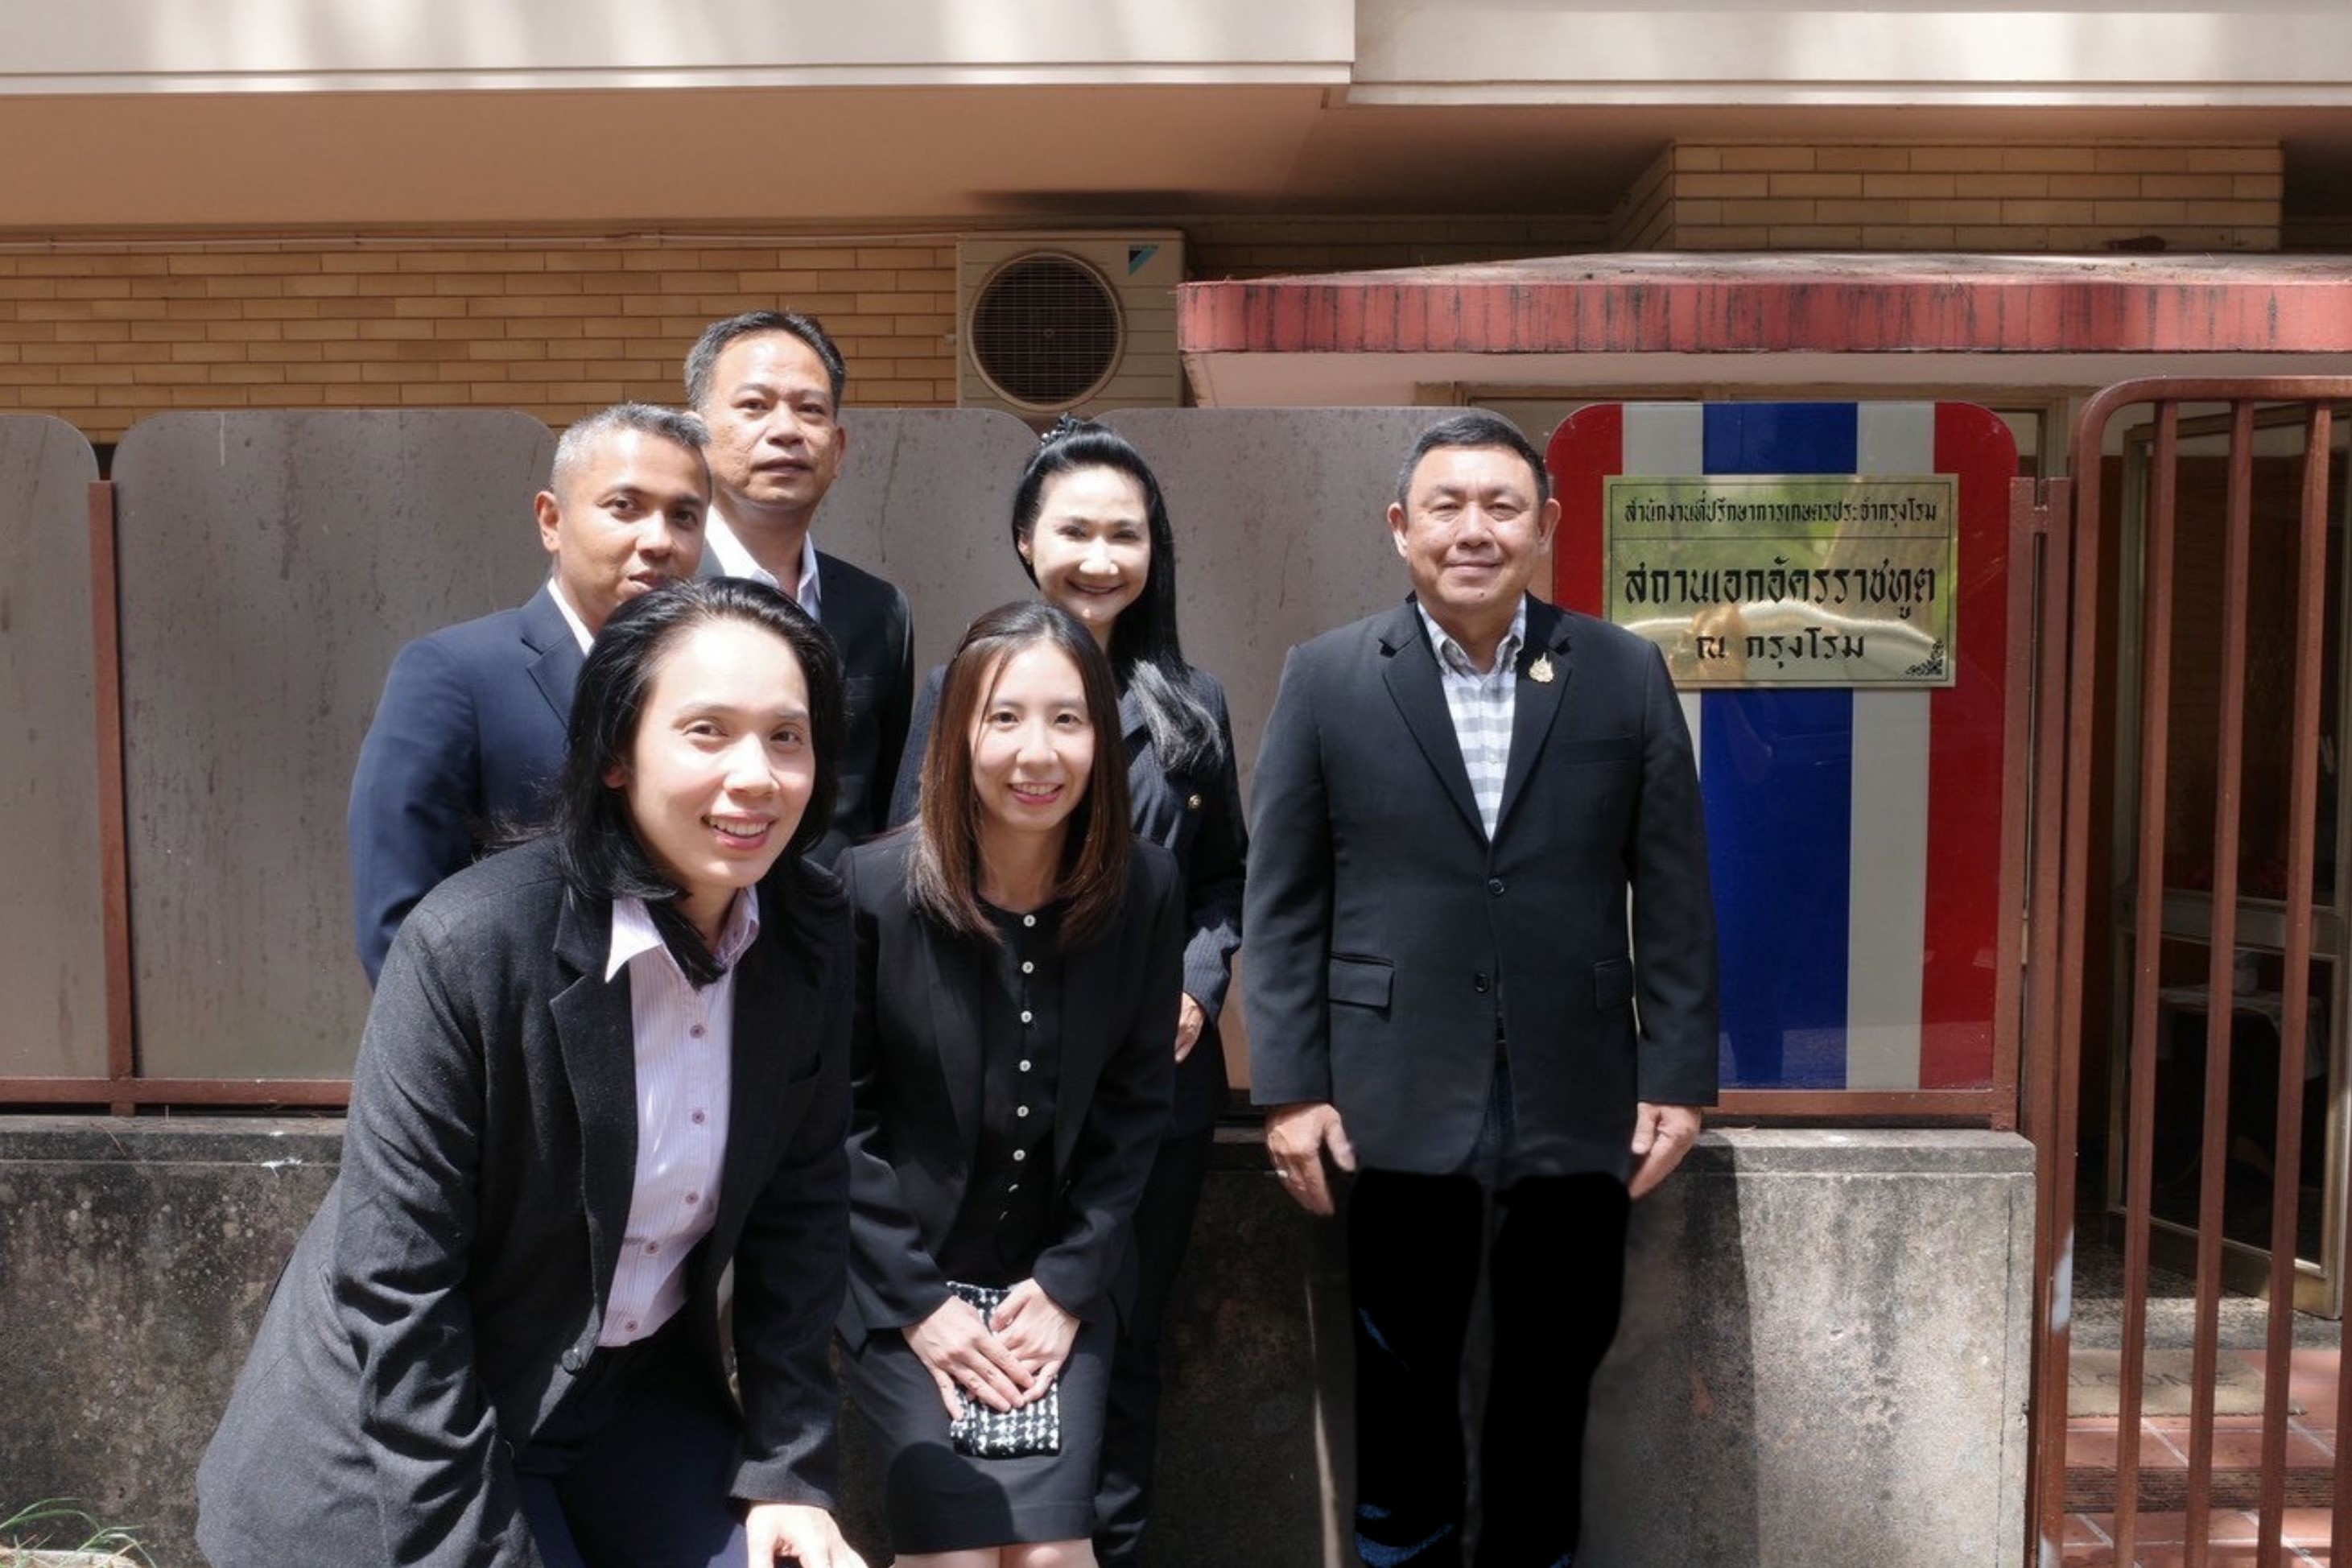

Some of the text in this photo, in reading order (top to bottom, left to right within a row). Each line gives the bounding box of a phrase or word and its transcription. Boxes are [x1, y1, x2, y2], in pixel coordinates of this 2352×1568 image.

[1625, 556, 1936, 619] สถานเอกอัครราชทูต
[1695, 627, 1865, 669] ณ กรุงโรม
